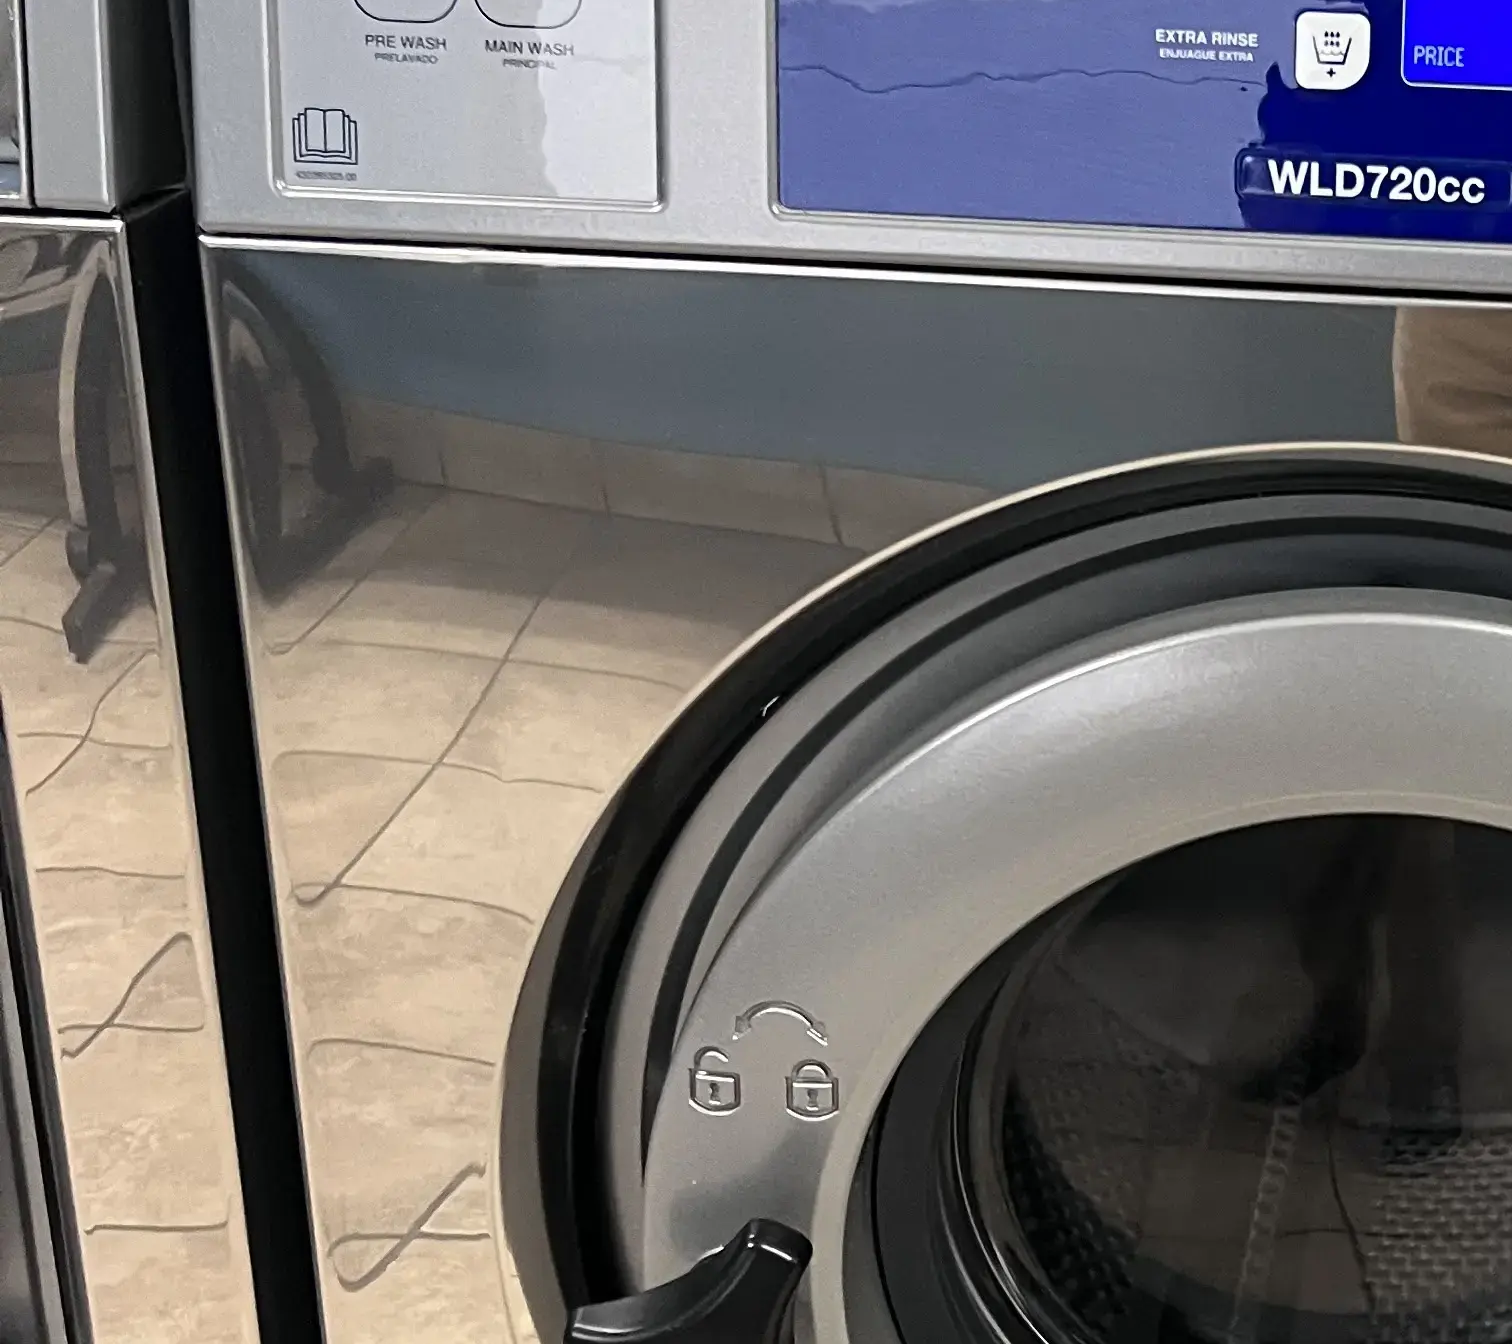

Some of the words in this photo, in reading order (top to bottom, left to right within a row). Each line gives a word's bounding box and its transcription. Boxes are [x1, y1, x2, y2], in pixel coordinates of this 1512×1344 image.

[365, 34, 396, 48] PRE
[400, 36, 447, 51] WASH
[1155, 28, 1208, 45] EXTRA
[1211, 32, 1259, 47] RINSE
[484, 39, 523, 54] MAIN
[527, 42, 575, 56] WASH
[1159, 48, 1217, 61] ENJUAGUE
[1219, 51, 1254, 62] EXTRA
[1413, 45, 1465, 67] PRICE
[1267, 159, 1485, 204] WLD720cc
